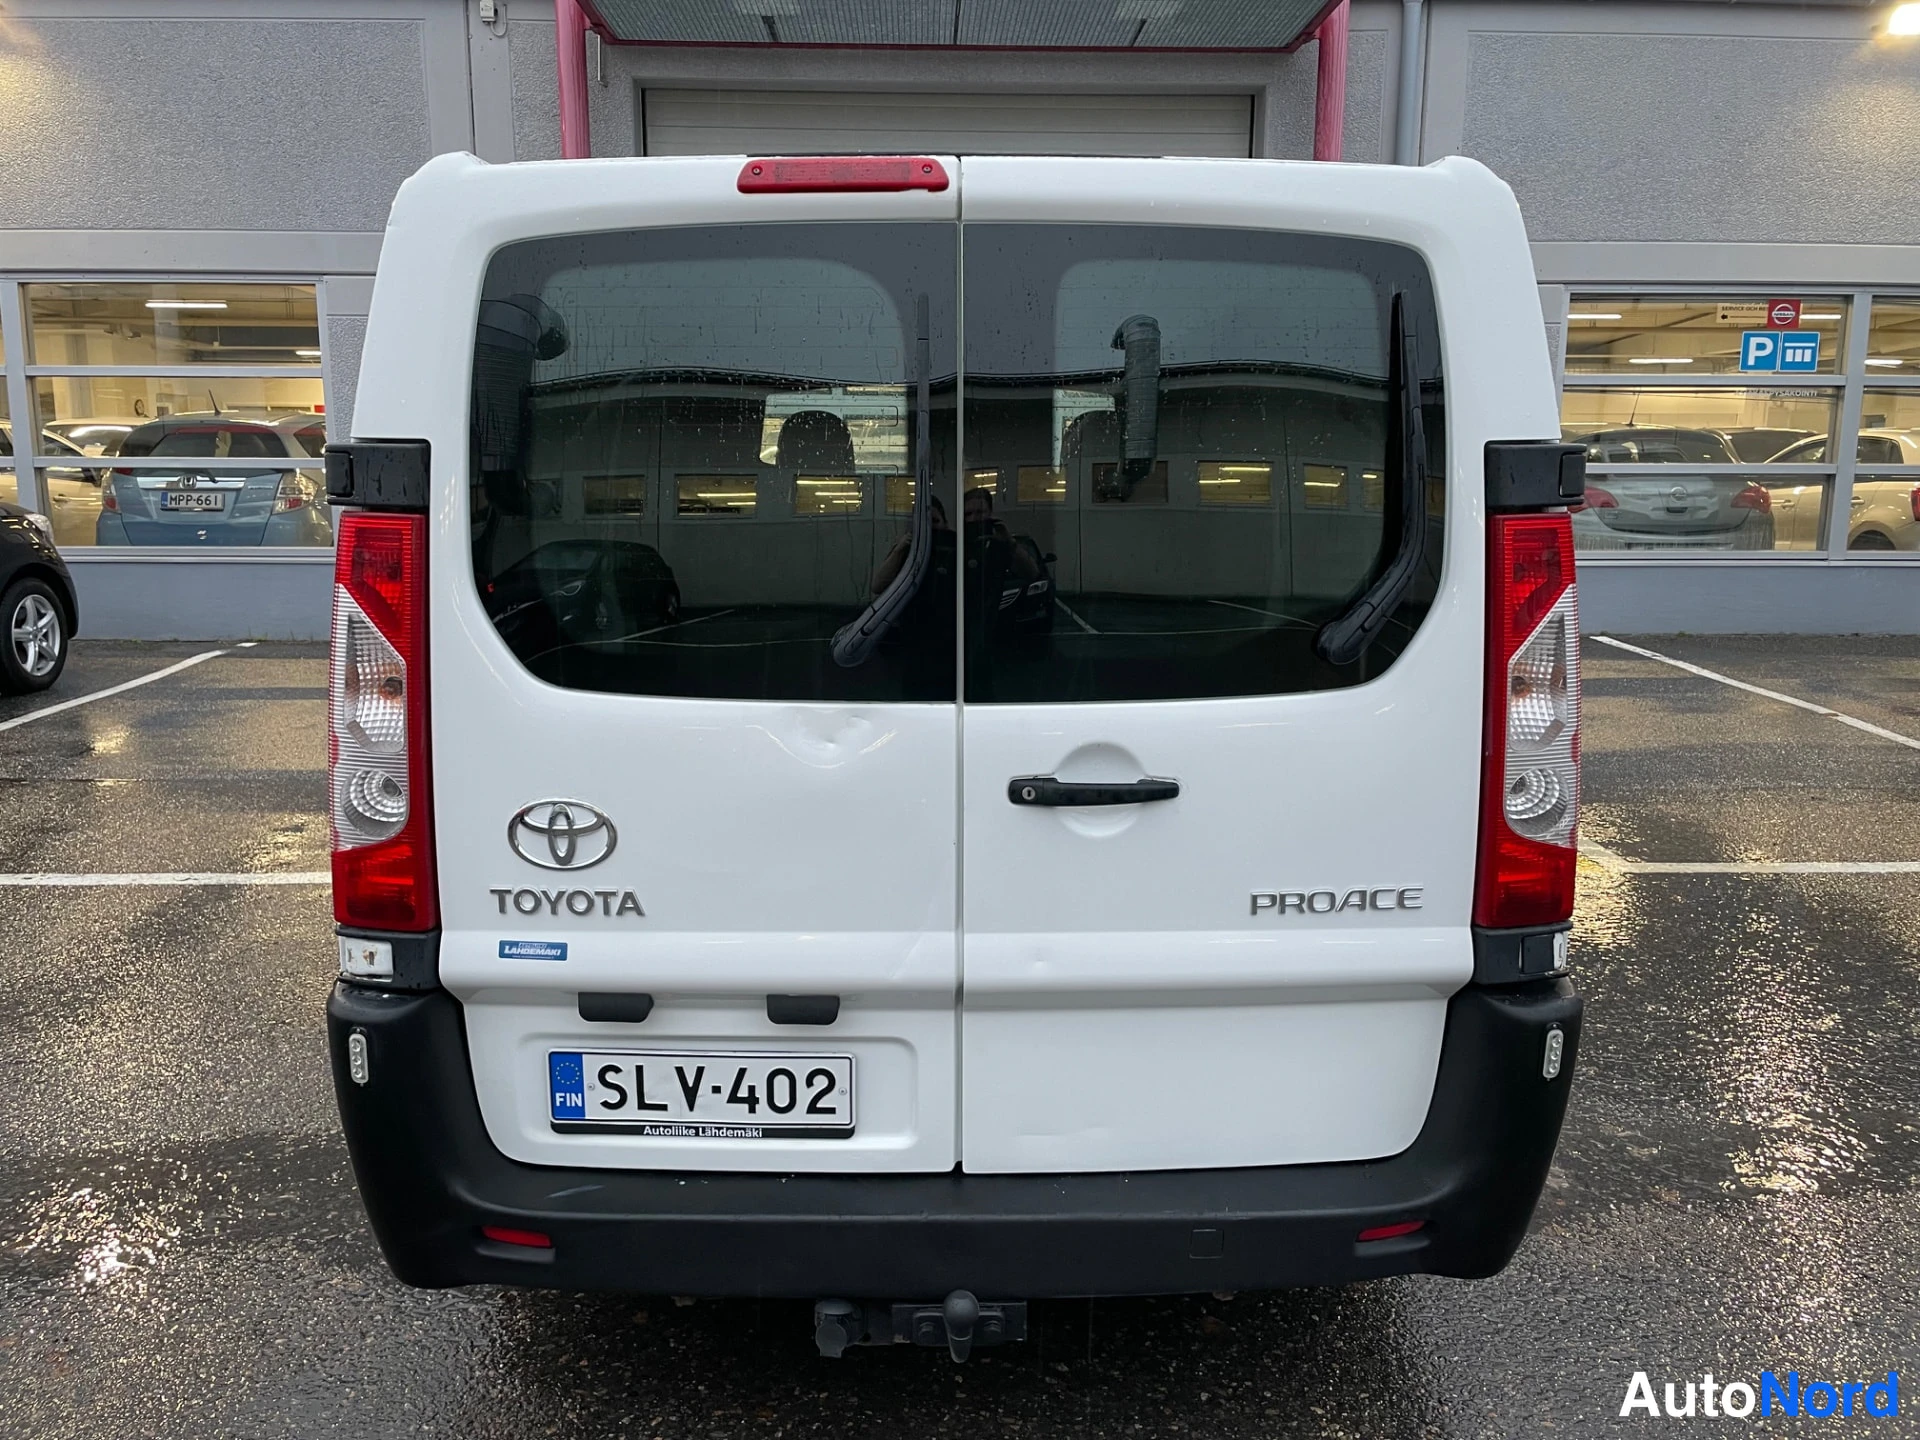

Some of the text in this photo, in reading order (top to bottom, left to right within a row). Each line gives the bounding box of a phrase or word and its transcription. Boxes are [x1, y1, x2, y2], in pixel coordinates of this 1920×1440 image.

[1748, 337, 1774, 366] P
[169, 494, 219, 506] MPP-661
[489, 888, 646, 917] TOYOTA
[1250, 886, 1424, 916] PROACE
[555, 1092, 583, 1108] FIN
[597, 1063, 838, 1116] SLV-402
[643, 1125, 763, 1138] Autoliike Lähdemäki
